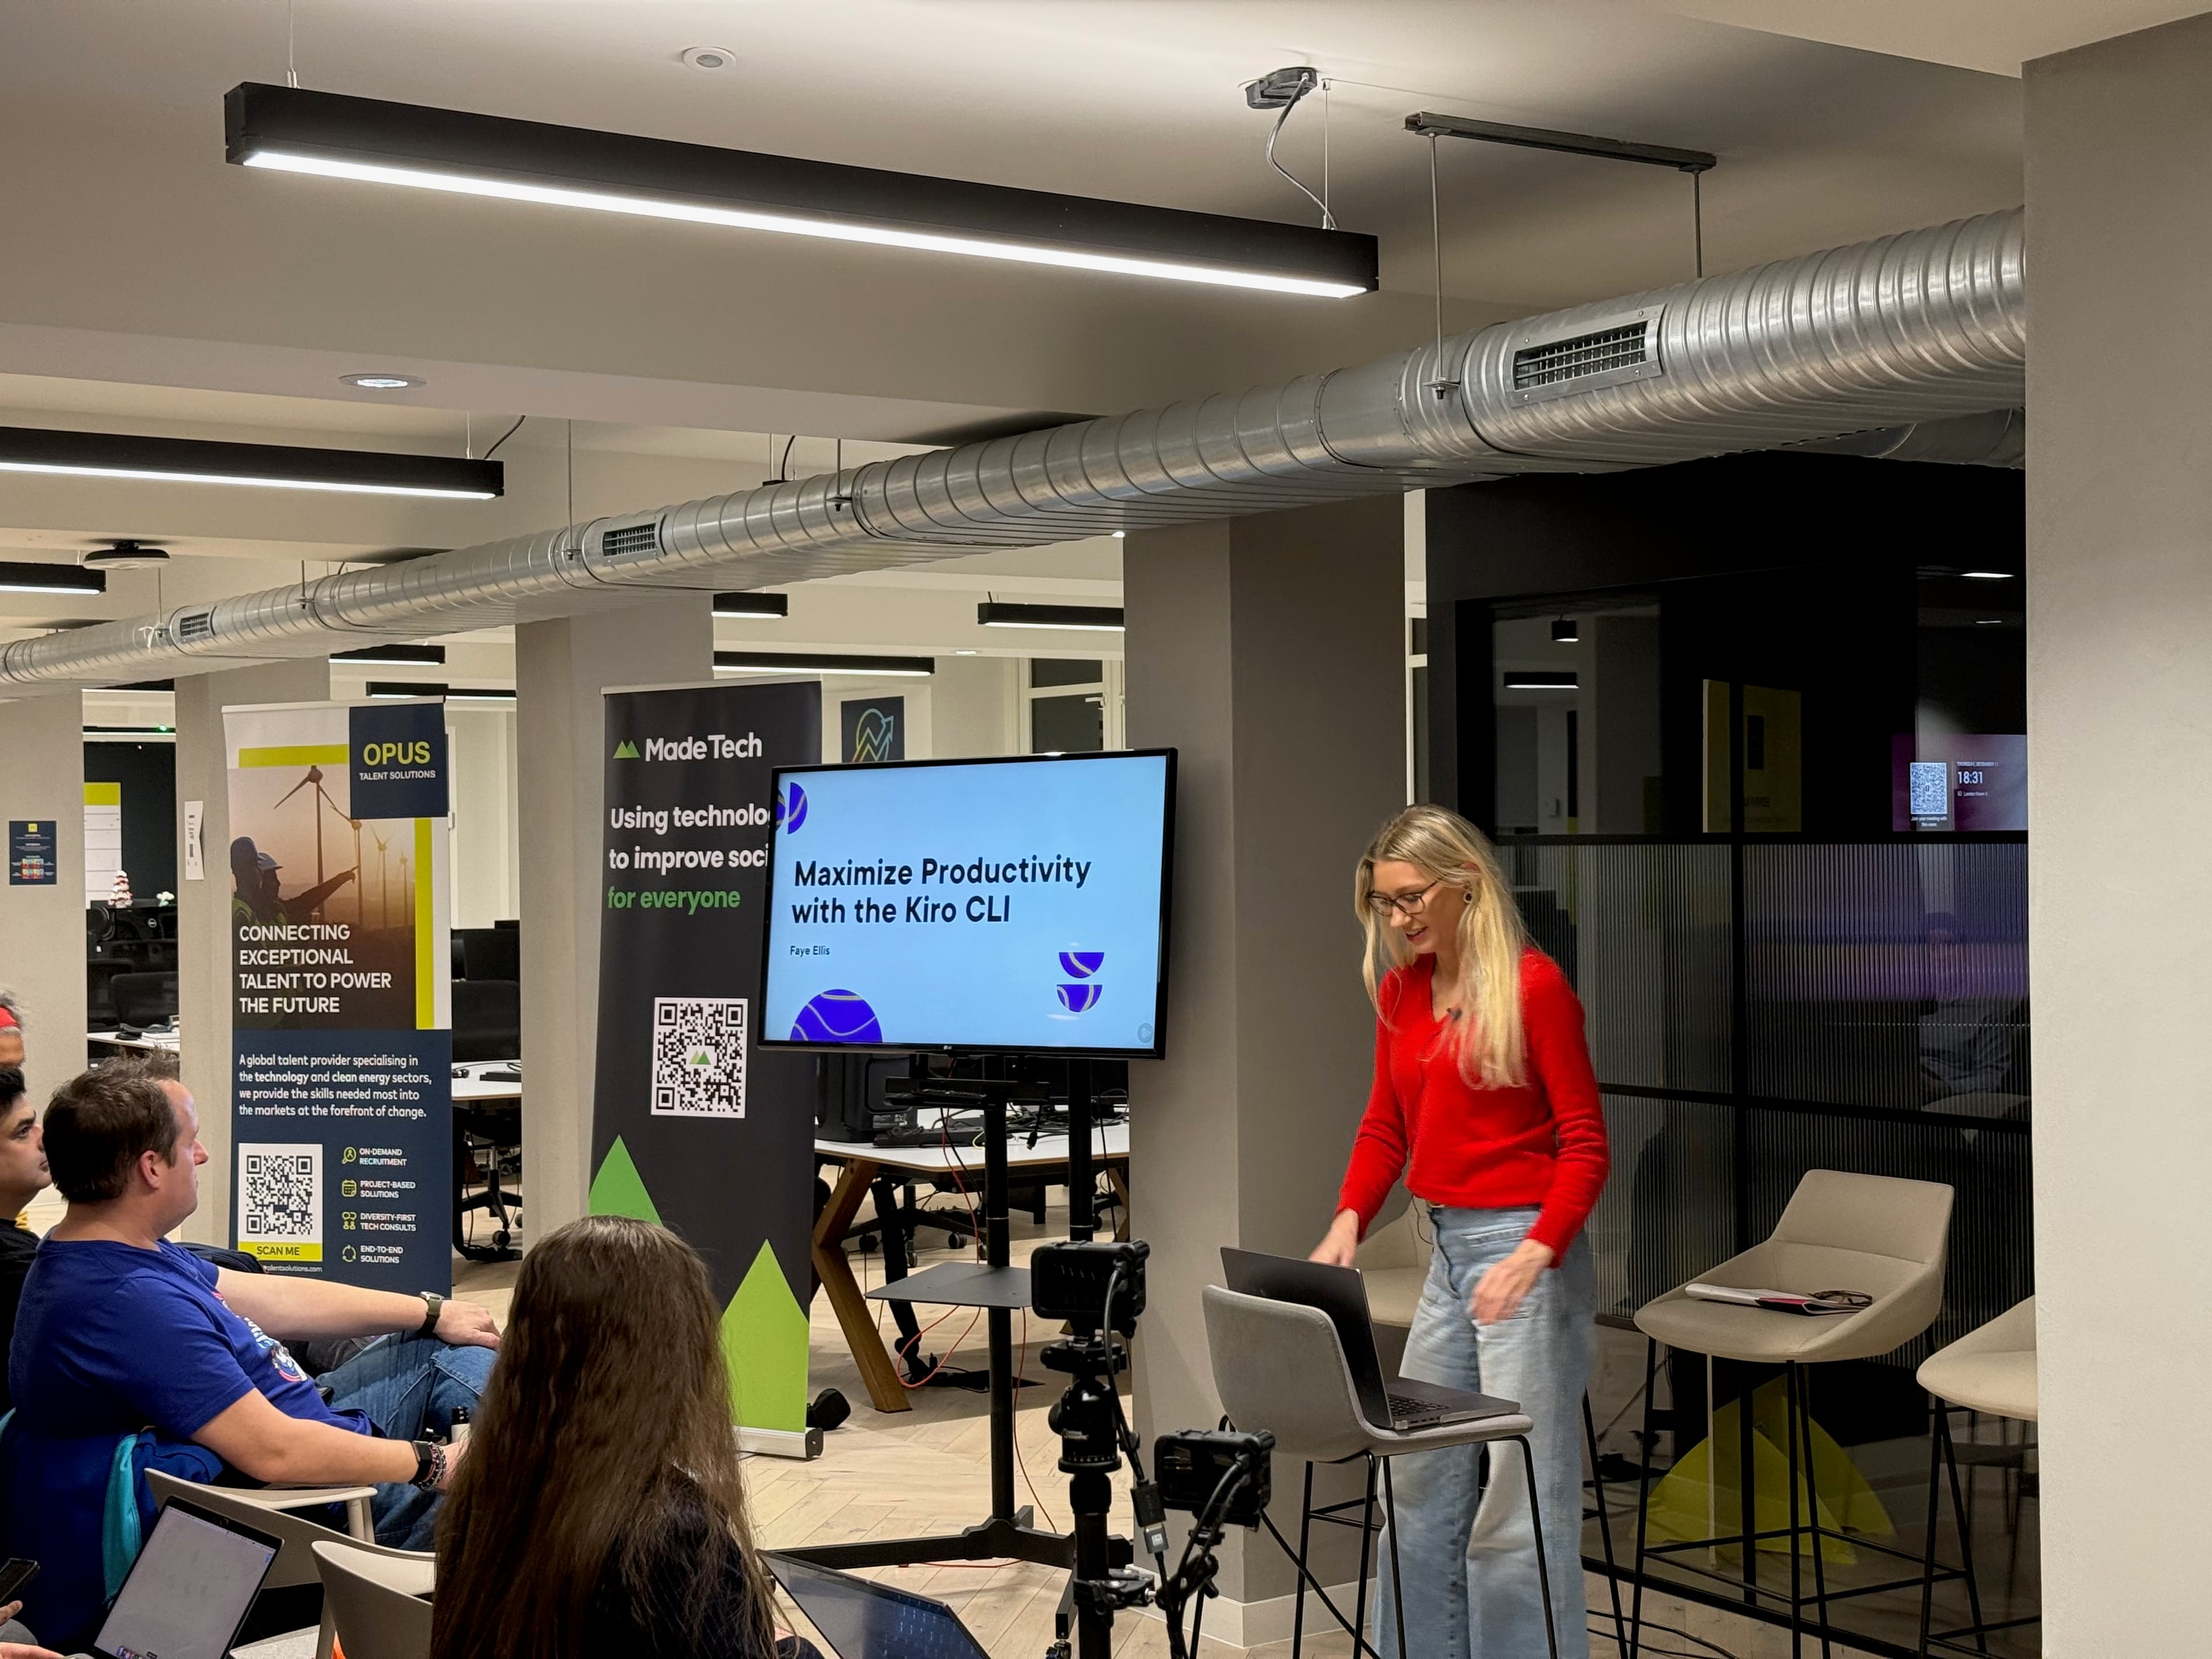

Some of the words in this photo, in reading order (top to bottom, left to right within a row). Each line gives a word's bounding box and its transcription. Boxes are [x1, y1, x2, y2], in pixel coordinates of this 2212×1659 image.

[363, 741, 430, 766] OPUS
[645, 736, 707, 762] Made
[708, 732, 762, 759] Tech
[359, 771, 388, 781] TALENT
[389, 770, 436, 779] SOLUTIONS
[1957, 771, 1983, 784] 18:31
[611, 805, 669, 835] Using
[673, 803, 770, 828] technolo
[609, 848, 630, 869] to
[634, 845, 724, 876] improve
[794, 858, 912, 887] Maximize
[922, 854, 1092, 889] Productivity
[608, 885, 636, 908] for
[640, 890, 741, 915] everyone
[791, 896, 845, 923] with
[854, 897, 896, 923] the
[906, 895, 956, 923] Kiro
[966, 895, 1010, 922] CLI
[240, 924, 350, 941] CONNECTING
[240, 948, 354, 965] EXCEPTIONAL
[790, 945, 810, 957] Faye
[813, 945, 830, 955] Ellis
[239, 973, 301, 989] TALENT
[302, 972, 327, 988] TO
[331, 972, 392, 988] POWER
[239, 997, 269, 1013] THE
[272, 997, 340, 1013] FUTURE
[239, 1054, 246, 1065] A
[247, 1054, 275, 1068] global
[278, 1054, 309, 1066] talent
[310, 1054, 351, 1068] provider
[353, 1054, 407, 1069] specialising
[409, 1054, 418, 1066] in
[239, 1070, 253, 1082] the
[255, 1070, 309, 1085] technology
[311, 1070, 329, 1082] and
[331, 1071, 357, 1082] clean
[359, 1074, 391, 1085] energy
[392, 1073, 432, 1085] sectors,
[239, 1090, 252, 1099] we
[253, 1087, 289, 1101] provide
[291, 1087, 309, 1099] the
[310, 1087, 334, 1099] skills
[336, 1088, 371, 1100] needed
[373, 1089, 398, 1100] most
[400, 1088, 420, 1100] into
[239, 1104, 253, 1115] the
[255, 1104, 296, 1116] markets
[297, 1105, 310, 1116] at
[312, 1104, 328, 1116] the
[330, 1104, 374, 1116] forefront
[376, 1105, 387, 1116] of
[388, 1105, 427, 1120] change.
[359, 1147, 403, 1156] ON-DEMAND
[359, 1157, 407, 1166] RECRUITMENT
[360, 1180, 416, 1189] PROJECT-BASED
[360, 1190, 399, 1199] SOLUTIONS
[360, 1213, 416, 1222] DIVERSITY-FIRST
[379, 1223, 416, 1232] CONSULTS
[256, 1246, 283, 1256] SCAN
[285, 1247, 300, 1256] ME
[361, 1245, 404, 1254] END-TO-END
[361, 1255, 400, 1264] SOLUTIONS
[264, 1264, 323, 1272] alentsolutions.com
